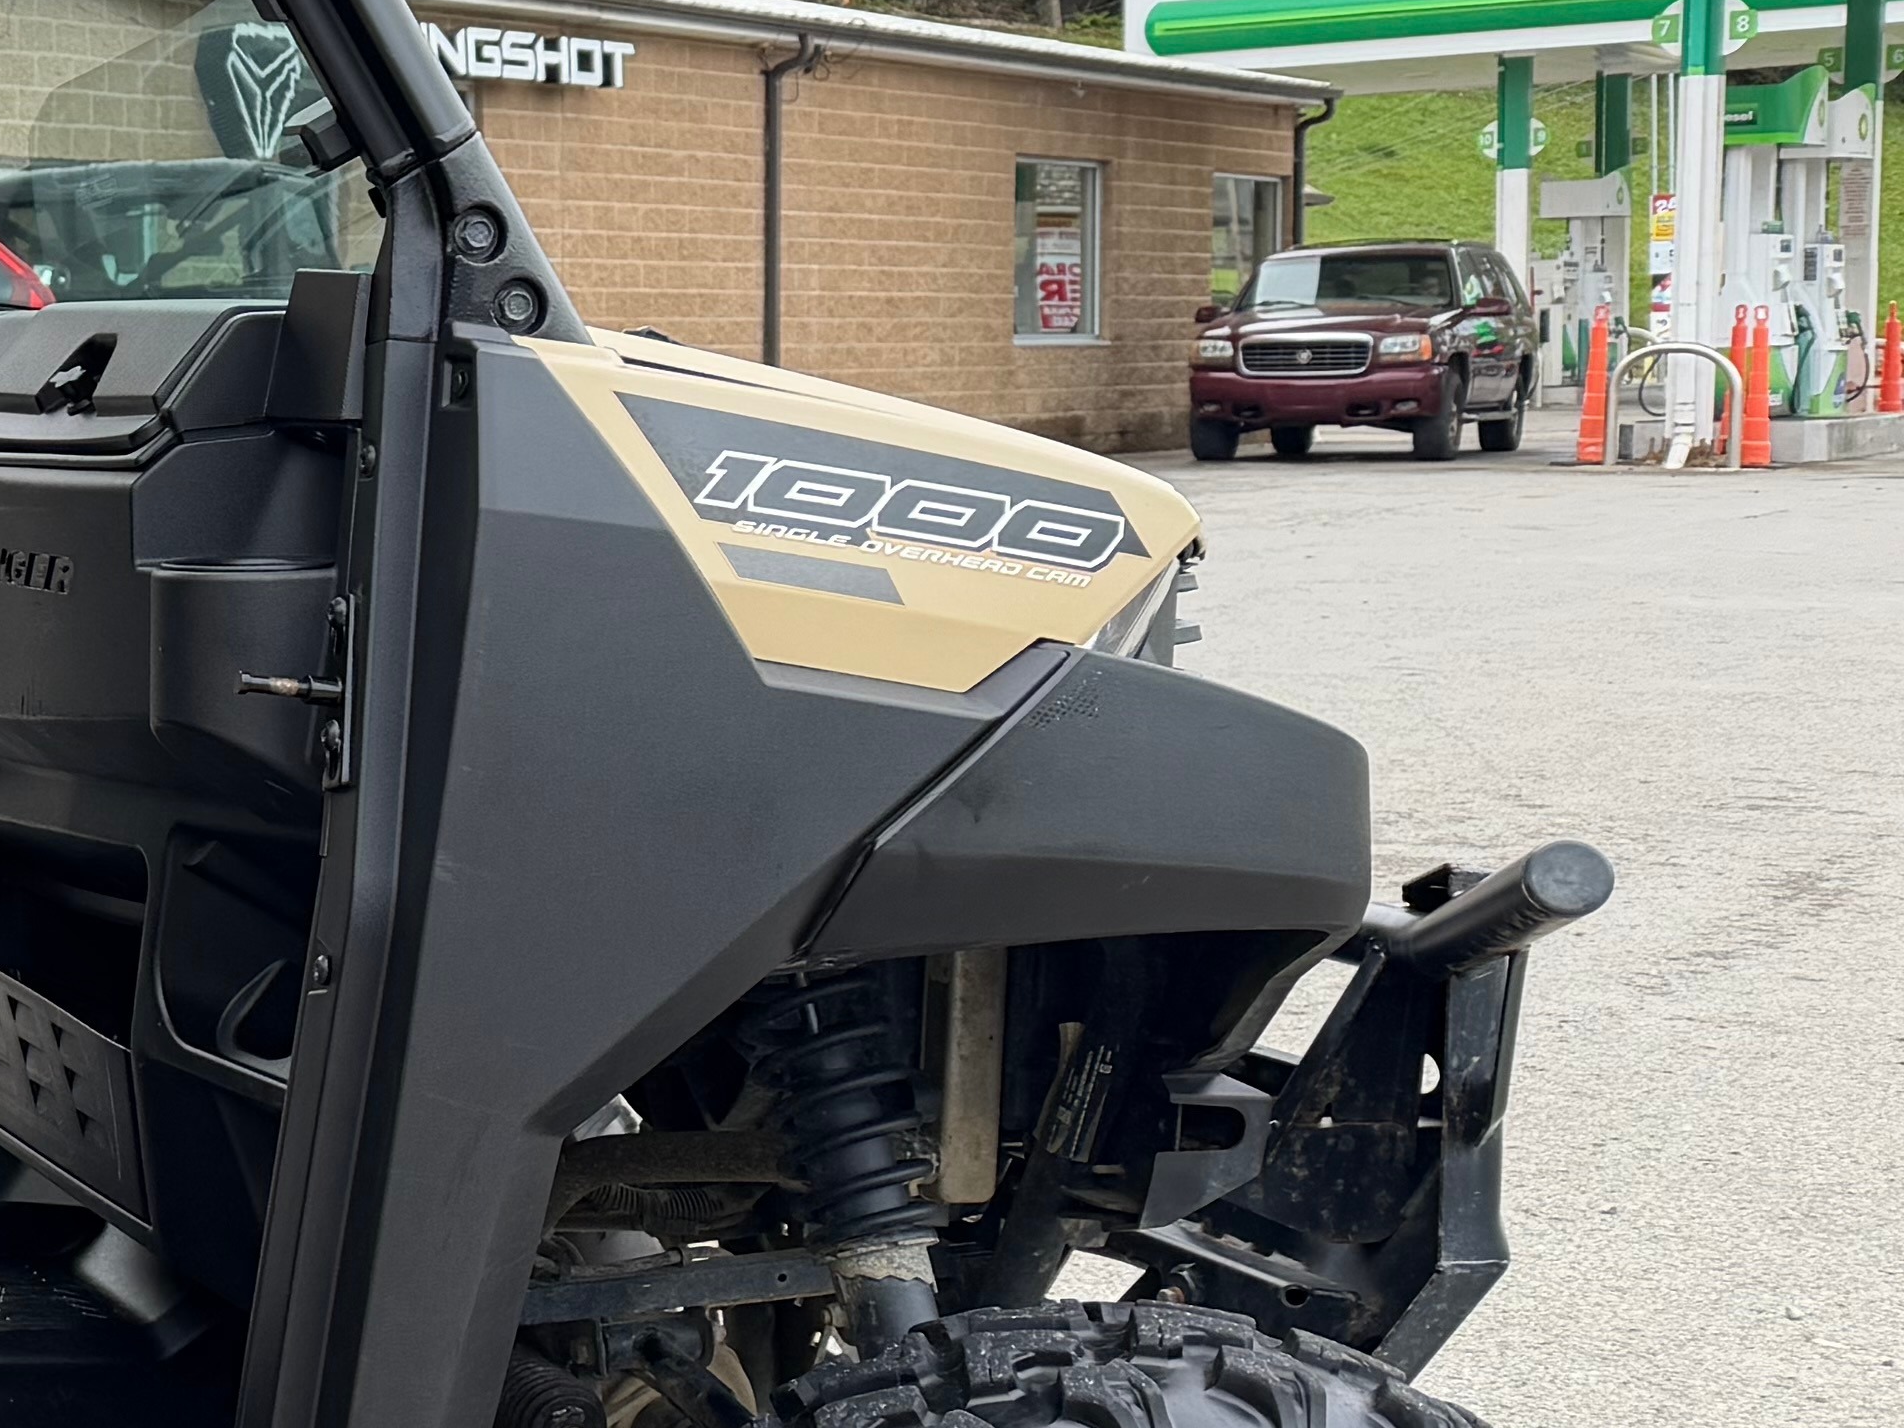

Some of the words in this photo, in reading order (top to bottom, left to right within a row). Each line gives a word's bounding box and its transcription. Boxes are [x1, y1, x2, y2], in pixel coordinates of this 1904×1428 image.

[1659, 19, 1671, 37] 7
[1736, 15, 1750, 32] 8
[1823, 52, 1835, 67] 5
[694, 449, 1126, 571] 1000
[732, 518, 850, 551] SINGLE
[857, 538, 1024, 579] OVERHEAD
[1026, 565, 1092, 589] CAM
